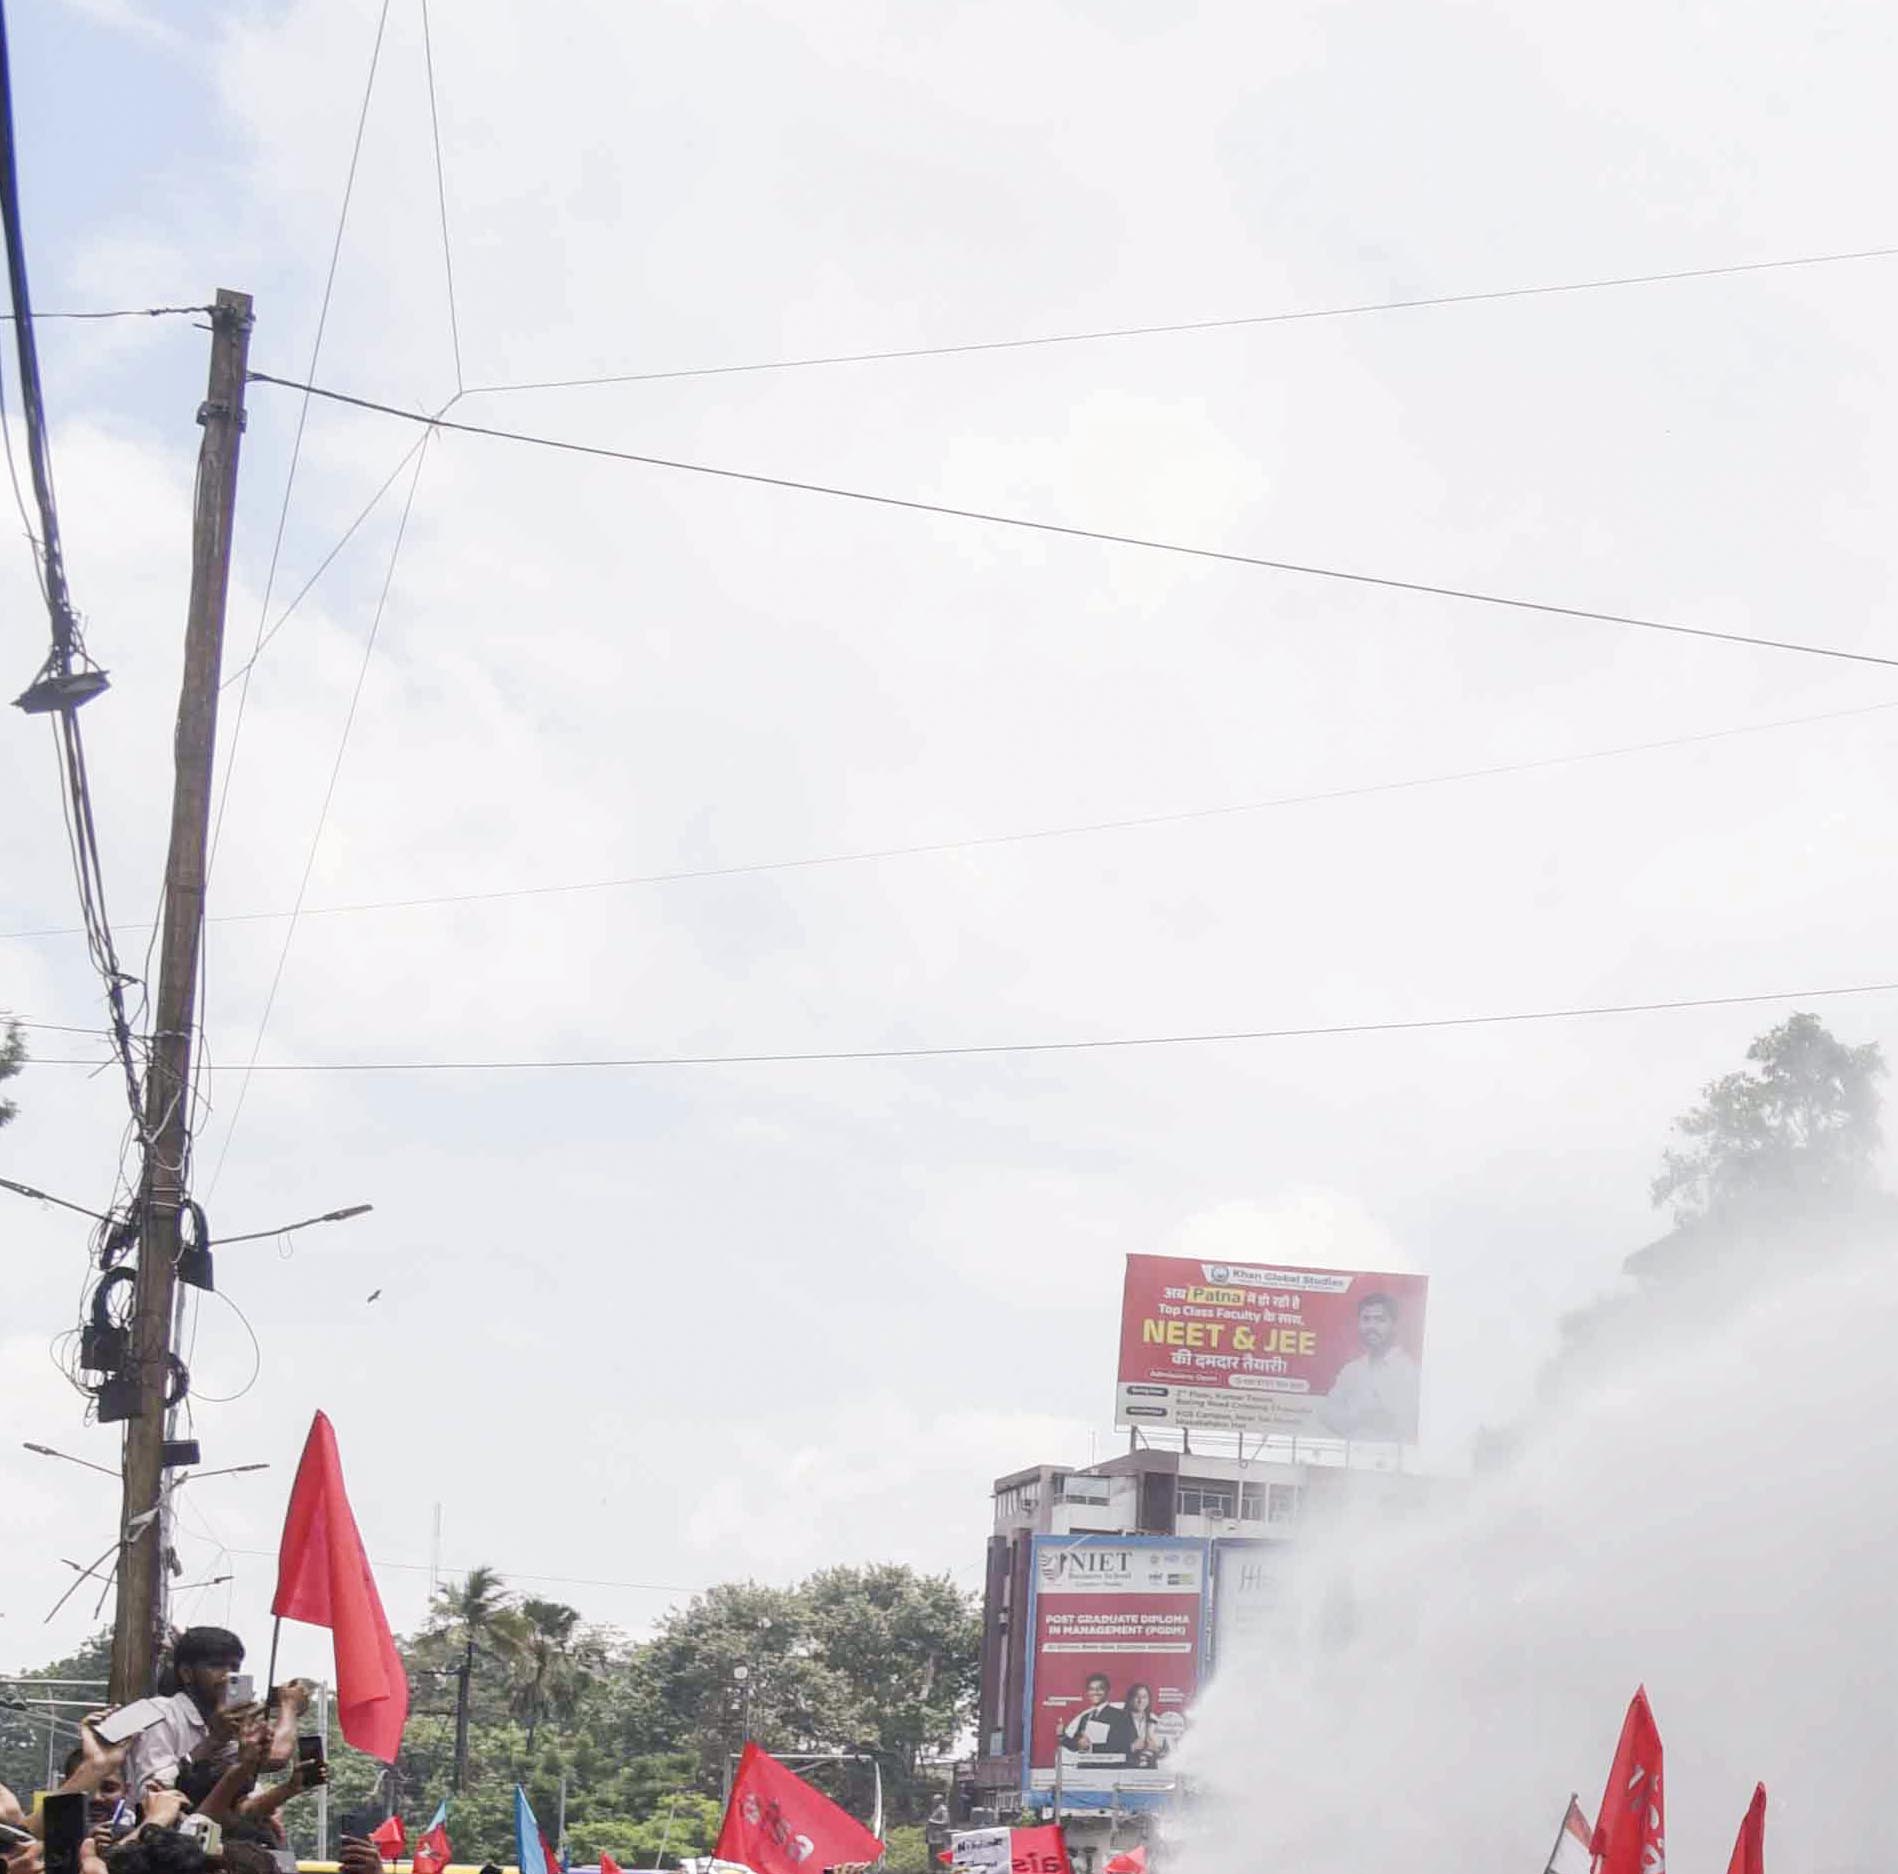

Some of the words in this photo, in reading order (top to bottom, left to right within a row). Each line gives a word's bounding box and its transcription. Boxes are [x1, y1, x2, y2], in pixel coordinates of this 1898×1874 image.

[1302, 1275, 1344, 1287] Studies
[1193, 1287, 1241, 1303] Patna
[1158, 1303, 1181, 1317] Top
[1183, 1305, 1215, 1317] Class
[1216, 1307, 1262, 1323] Faculty
[1142, 1318, 1226, 1349] NEET
[1232, 1326, 1256, 1351] &
[1263, 1328, 1317, 1355] JEE
[1070, 1551, 1133, 1572] NIET
[1045, 1614, 1074, 1624] POST
[1077, 1614, 1139, 1624] GRADUATE
[1140, 1614, 1190, 1624] DIPLOMA
[1063, 1625, 1142, 1636] MANAGEMENT
